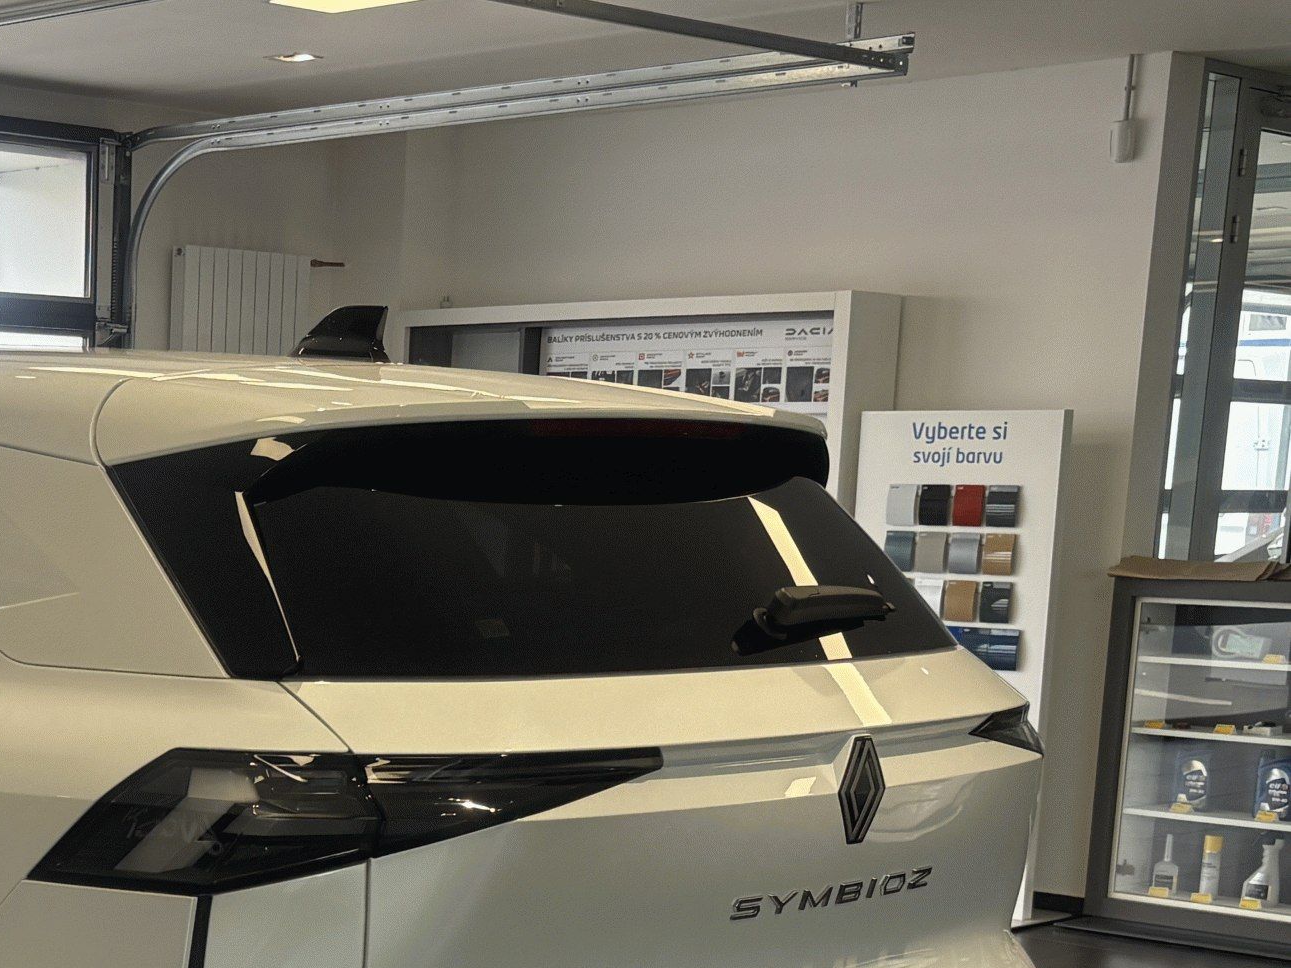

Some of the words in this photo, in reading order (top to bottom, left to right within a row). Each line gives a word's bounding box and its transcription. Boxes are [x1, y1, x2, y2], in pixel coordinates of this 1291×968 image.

[547, 332, 573, 344] BALÍKY
[643, 332, 653, 341] 20
[655, 332, 662, 340] %
[662, 329, 701, 340] CENOVÝM
[912, 421, 987, 444] Vyberte
[992, 421, 1008, 440] si
[913, 447, 951, 467] svojí
[956, 447, 1003, 464] barvu
[729, 865, 933, 921] SYMBIOZ
